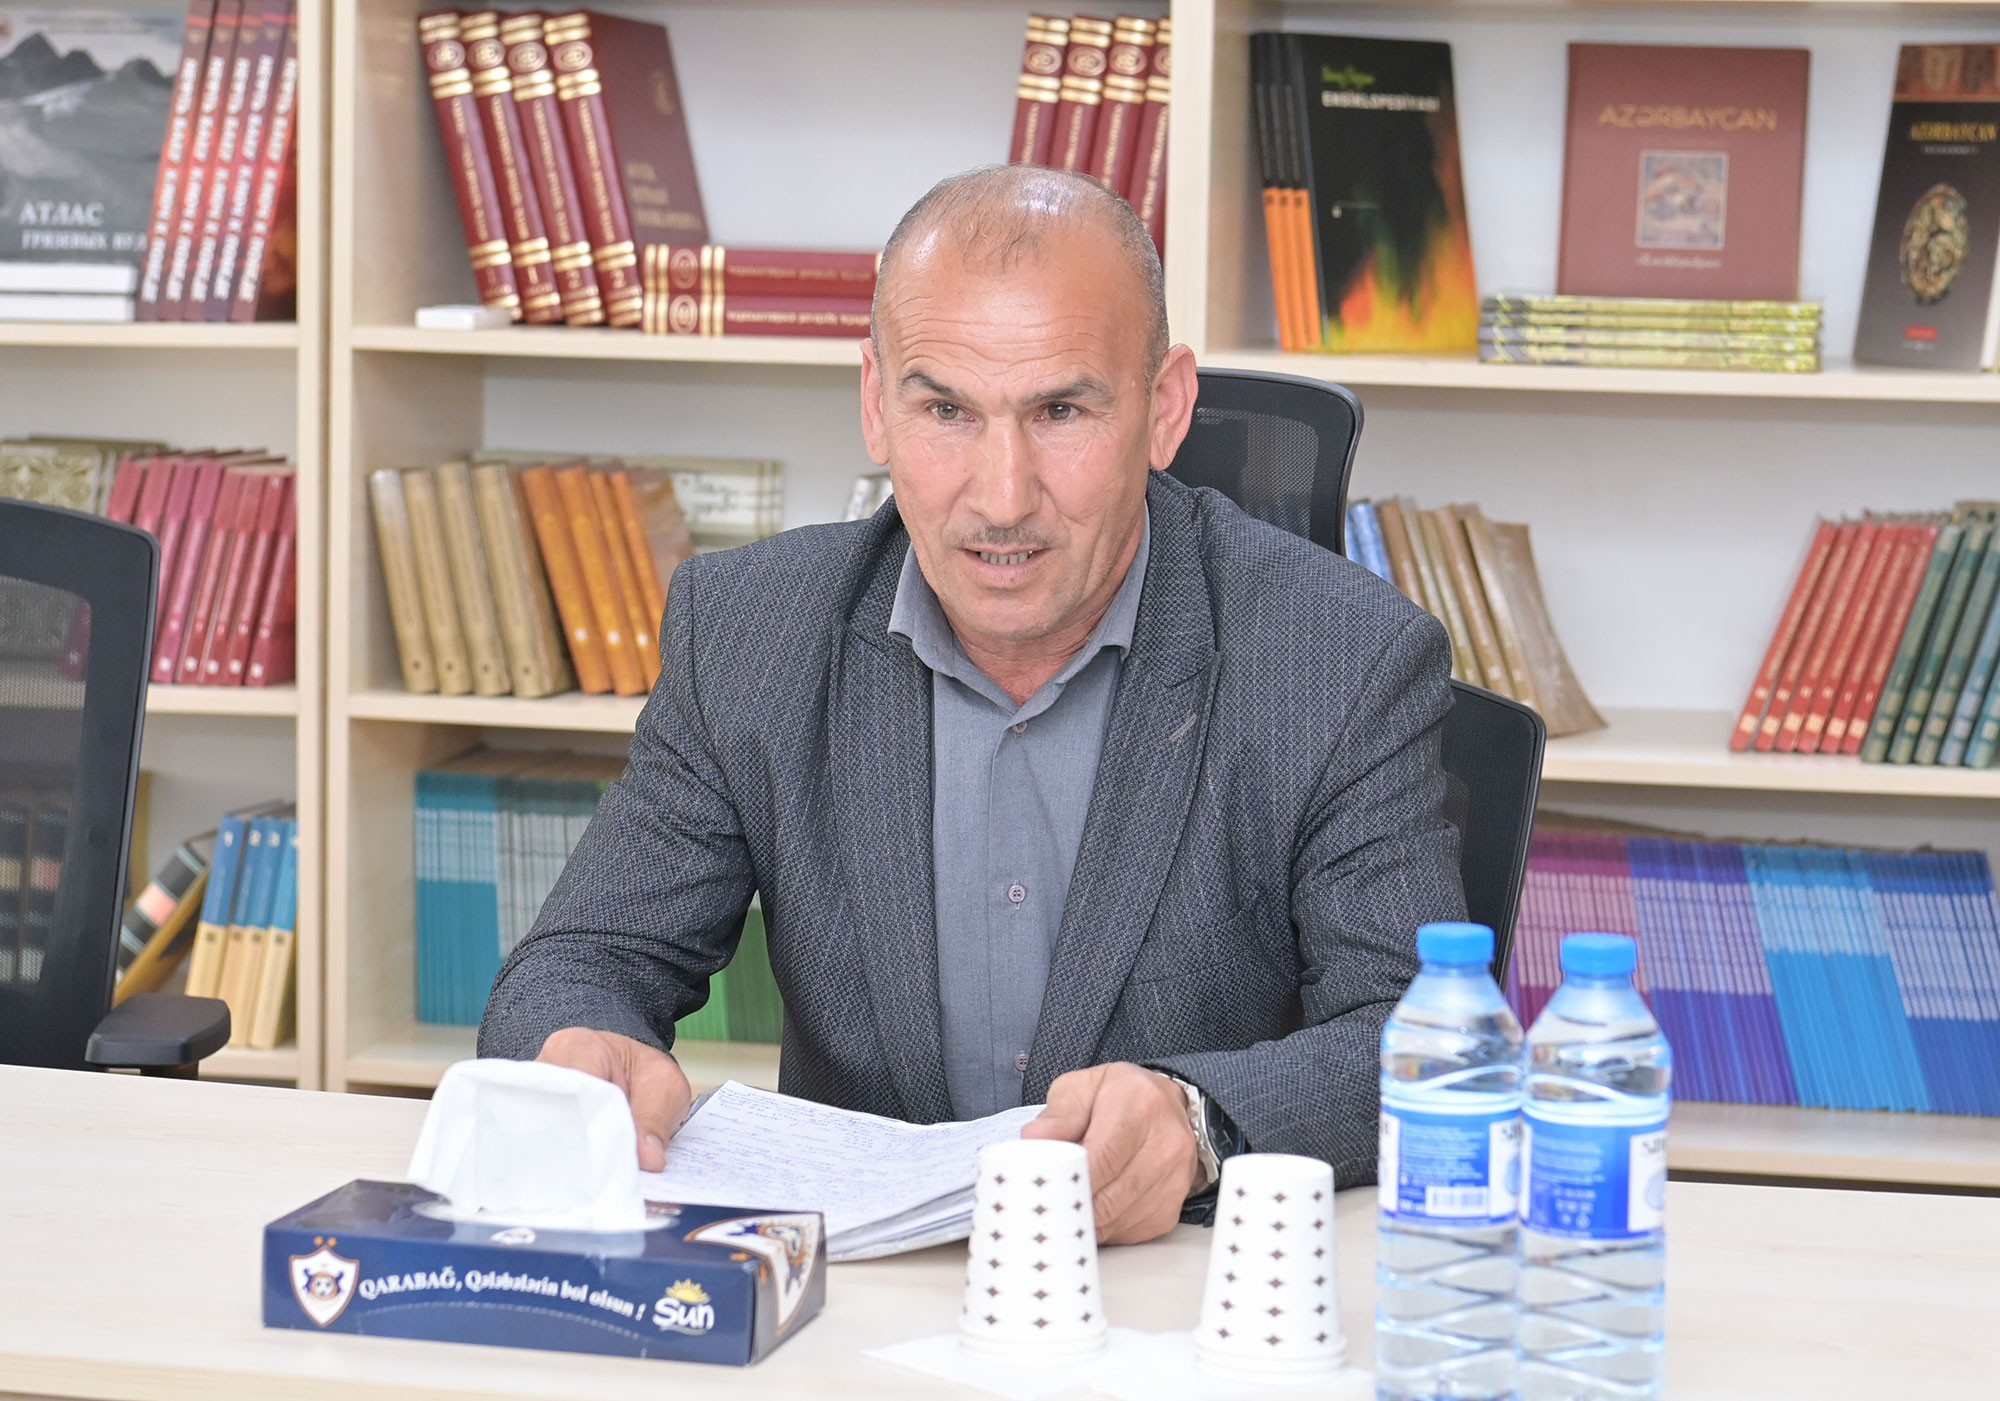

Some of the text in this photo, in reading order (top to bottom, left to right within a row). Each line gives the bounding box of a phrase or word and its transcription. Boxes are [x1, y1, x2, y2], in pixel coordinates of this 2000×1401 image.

[1599, 104, 1777, 131] AZƏRBAYCAN
[19, 201, 104, 226] АТЛАС
[358, 1266, 463, 1300] QARABAĞ,
[560, 1279, 589, 1303] bol
[588, 1289, 635, 1318] olsun
[652, 1296, 716, 1330] Sun
